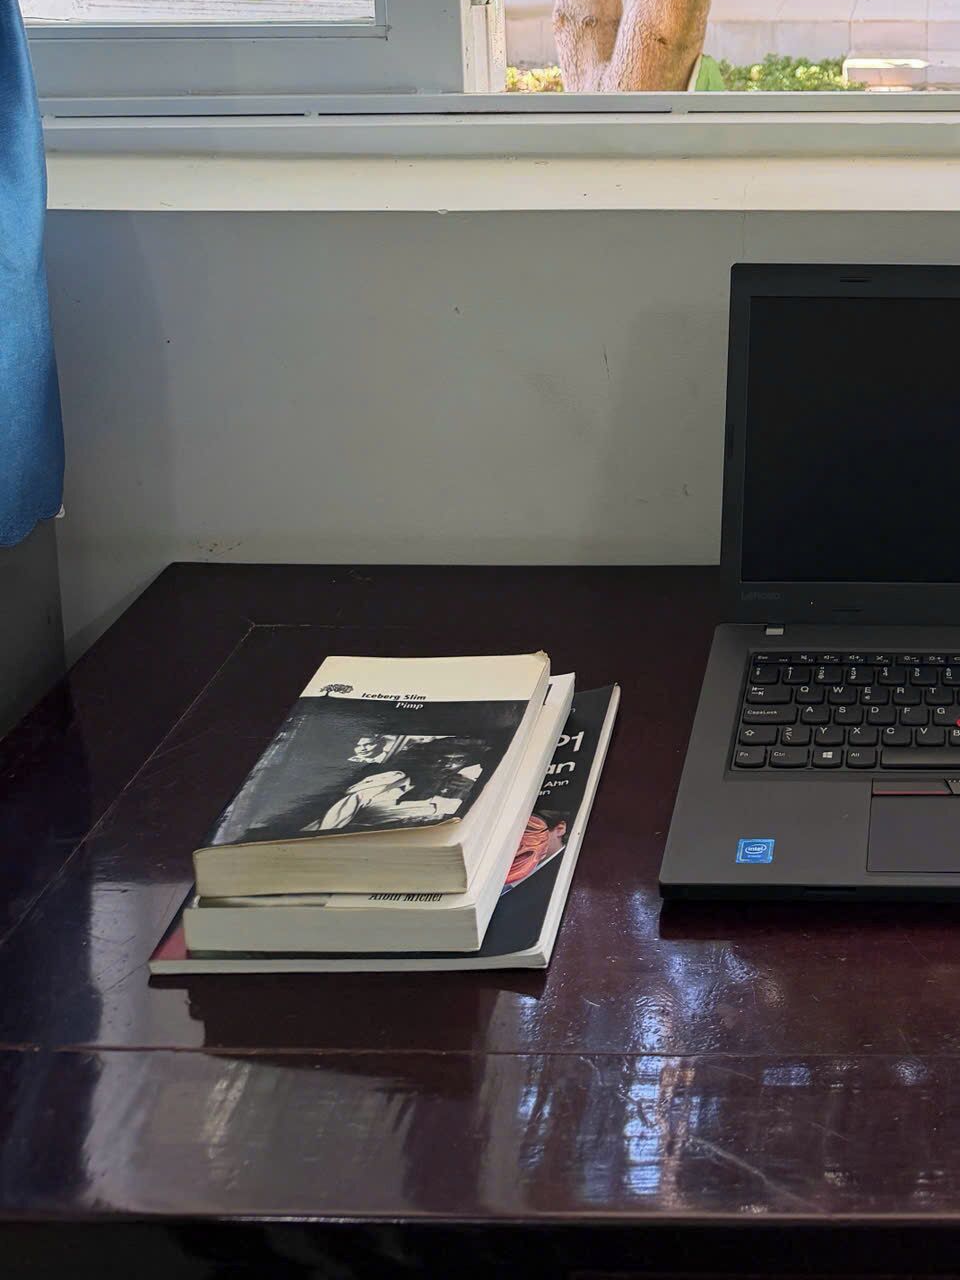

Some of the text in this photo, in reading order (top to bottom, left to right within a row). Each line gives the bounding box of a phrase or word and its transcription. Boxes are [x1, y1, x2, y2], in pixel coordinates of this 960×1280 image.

[361, 692, 401, 701] Iceberg
[396, 702, 424, 710] Pimp
[820, 726, 828, 734] Y
